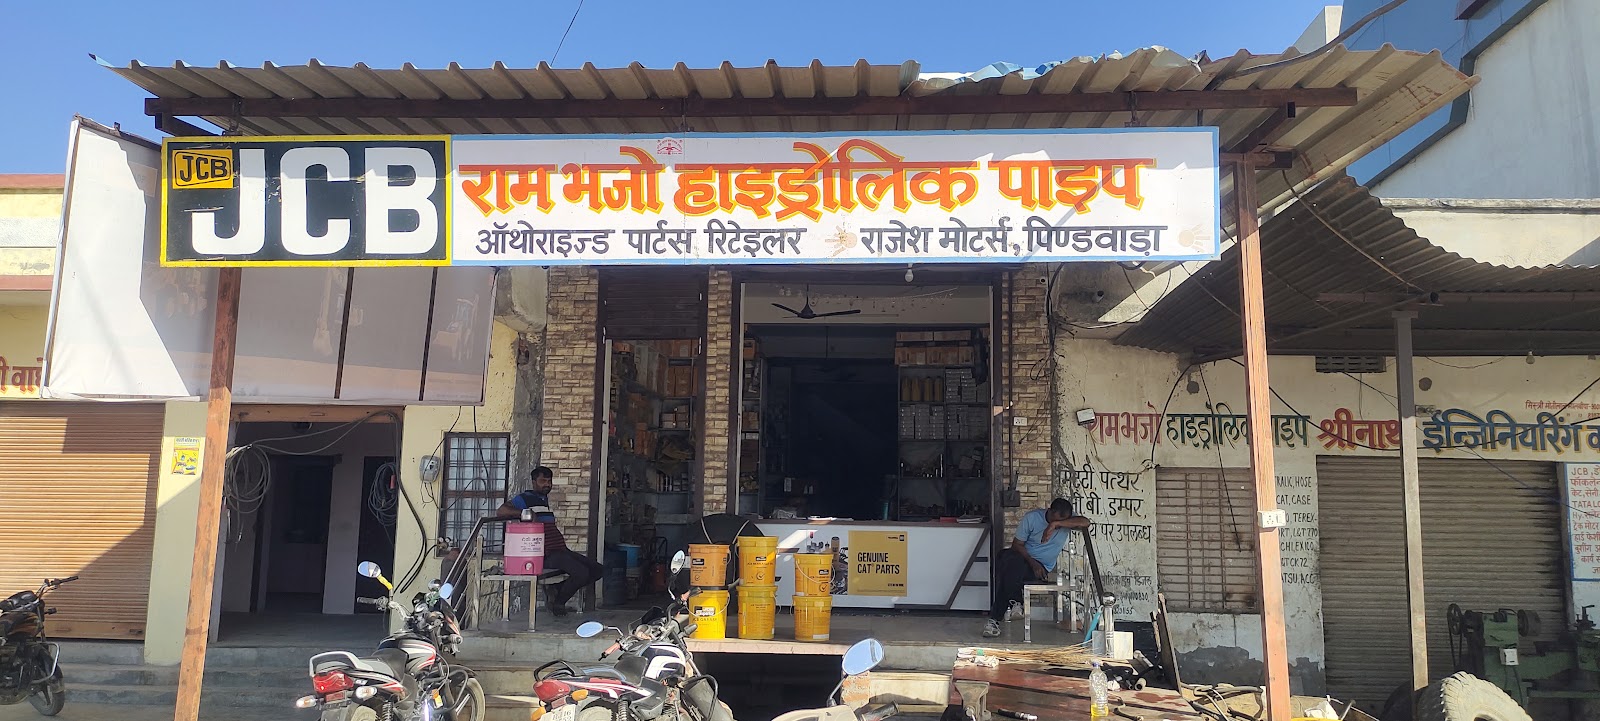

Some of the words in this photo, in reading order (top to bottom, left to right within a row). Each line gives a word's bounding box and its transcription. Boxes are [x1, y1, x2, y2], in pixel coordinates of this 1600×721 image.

[180, 155, 229, 183] JCB
[673, 138, 980, 222] हाइड्रोलिक
[988, 158, 1156, 214] पाइप
[192, 147, 438, 255] JCB
[475, 220, 615, 257] ऑथोराइज्ड
[860, 219, 934, 254] राजेश
[1571, 467, 1589, 476] JCB
[1295, 476, 1312, 488] HOSE
[1108, 497, 1147, 519] डम्पर,
[1291, 494, 1311, 505] CASE
[1100, 523, 1115, 542] पर
[1116, 523, 1152, 543] उपलब्ध
[857, 552, 889, 563] GENUINE
[875, 564, 900, 575] PARTS
